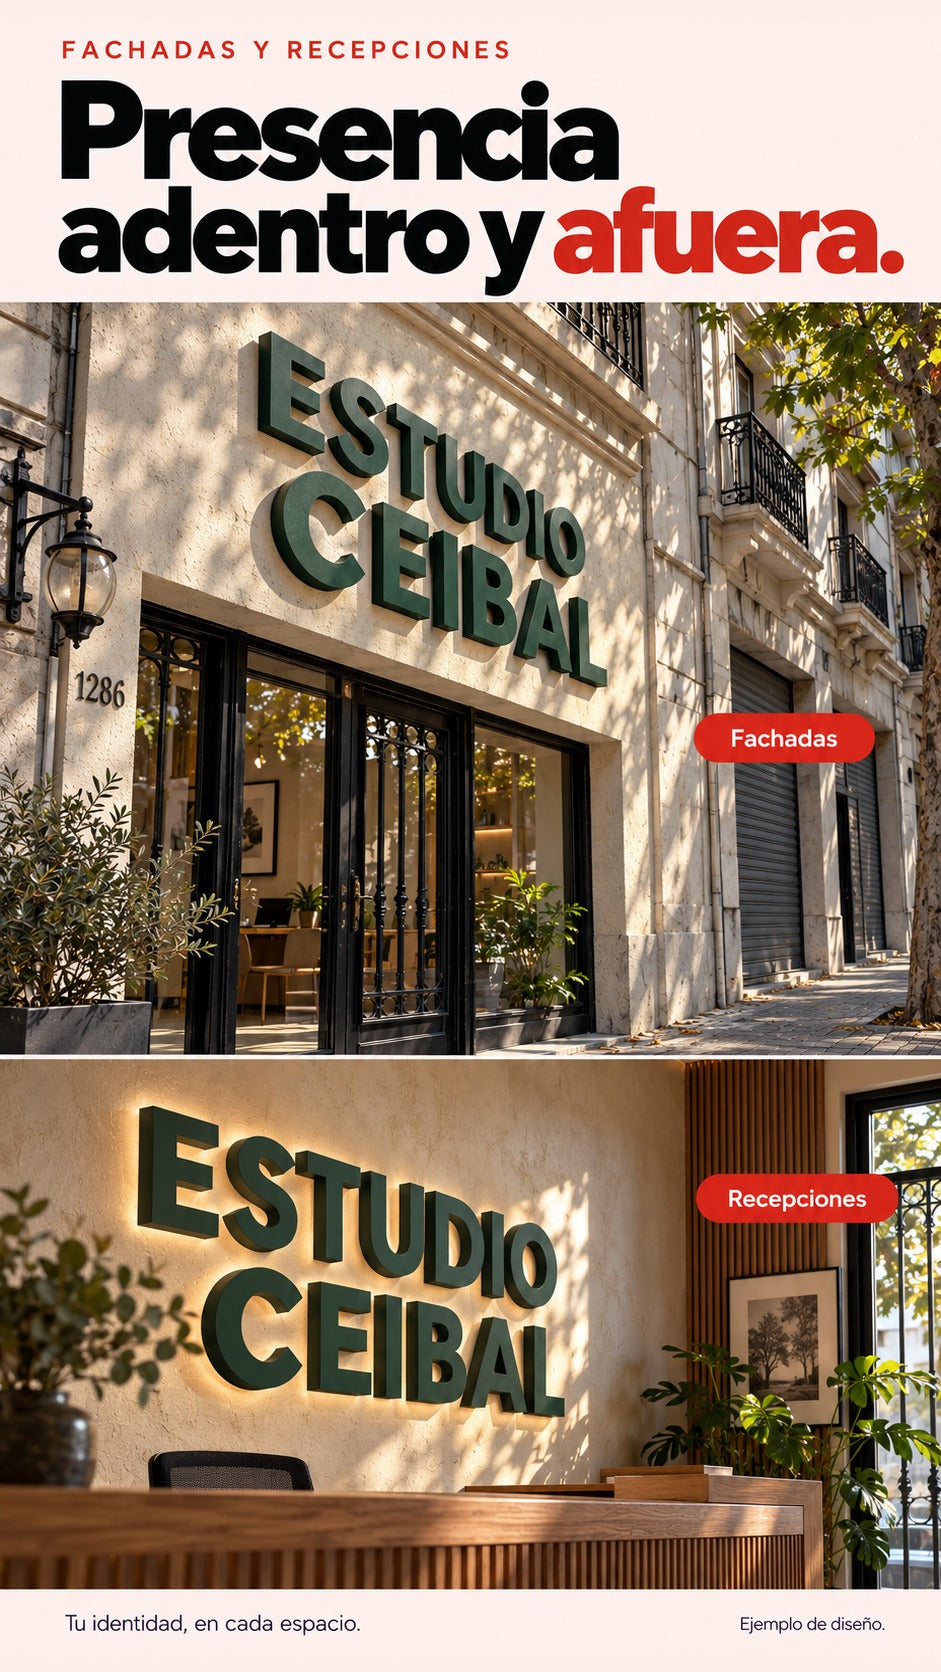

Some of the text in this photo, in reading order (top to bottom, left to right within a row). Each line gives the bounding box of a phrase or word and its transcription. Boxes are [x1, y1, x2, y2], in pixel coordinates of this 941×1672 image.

[258, 331, 586, 577] ESTUDIO
[270, 470, 608, 688] CEIBAL
[74, 670, 125, 708] 1286
[137, 1105, 558, 1309] ESTUDIO
[201, 1267, 565, 1418] CEIBAL
